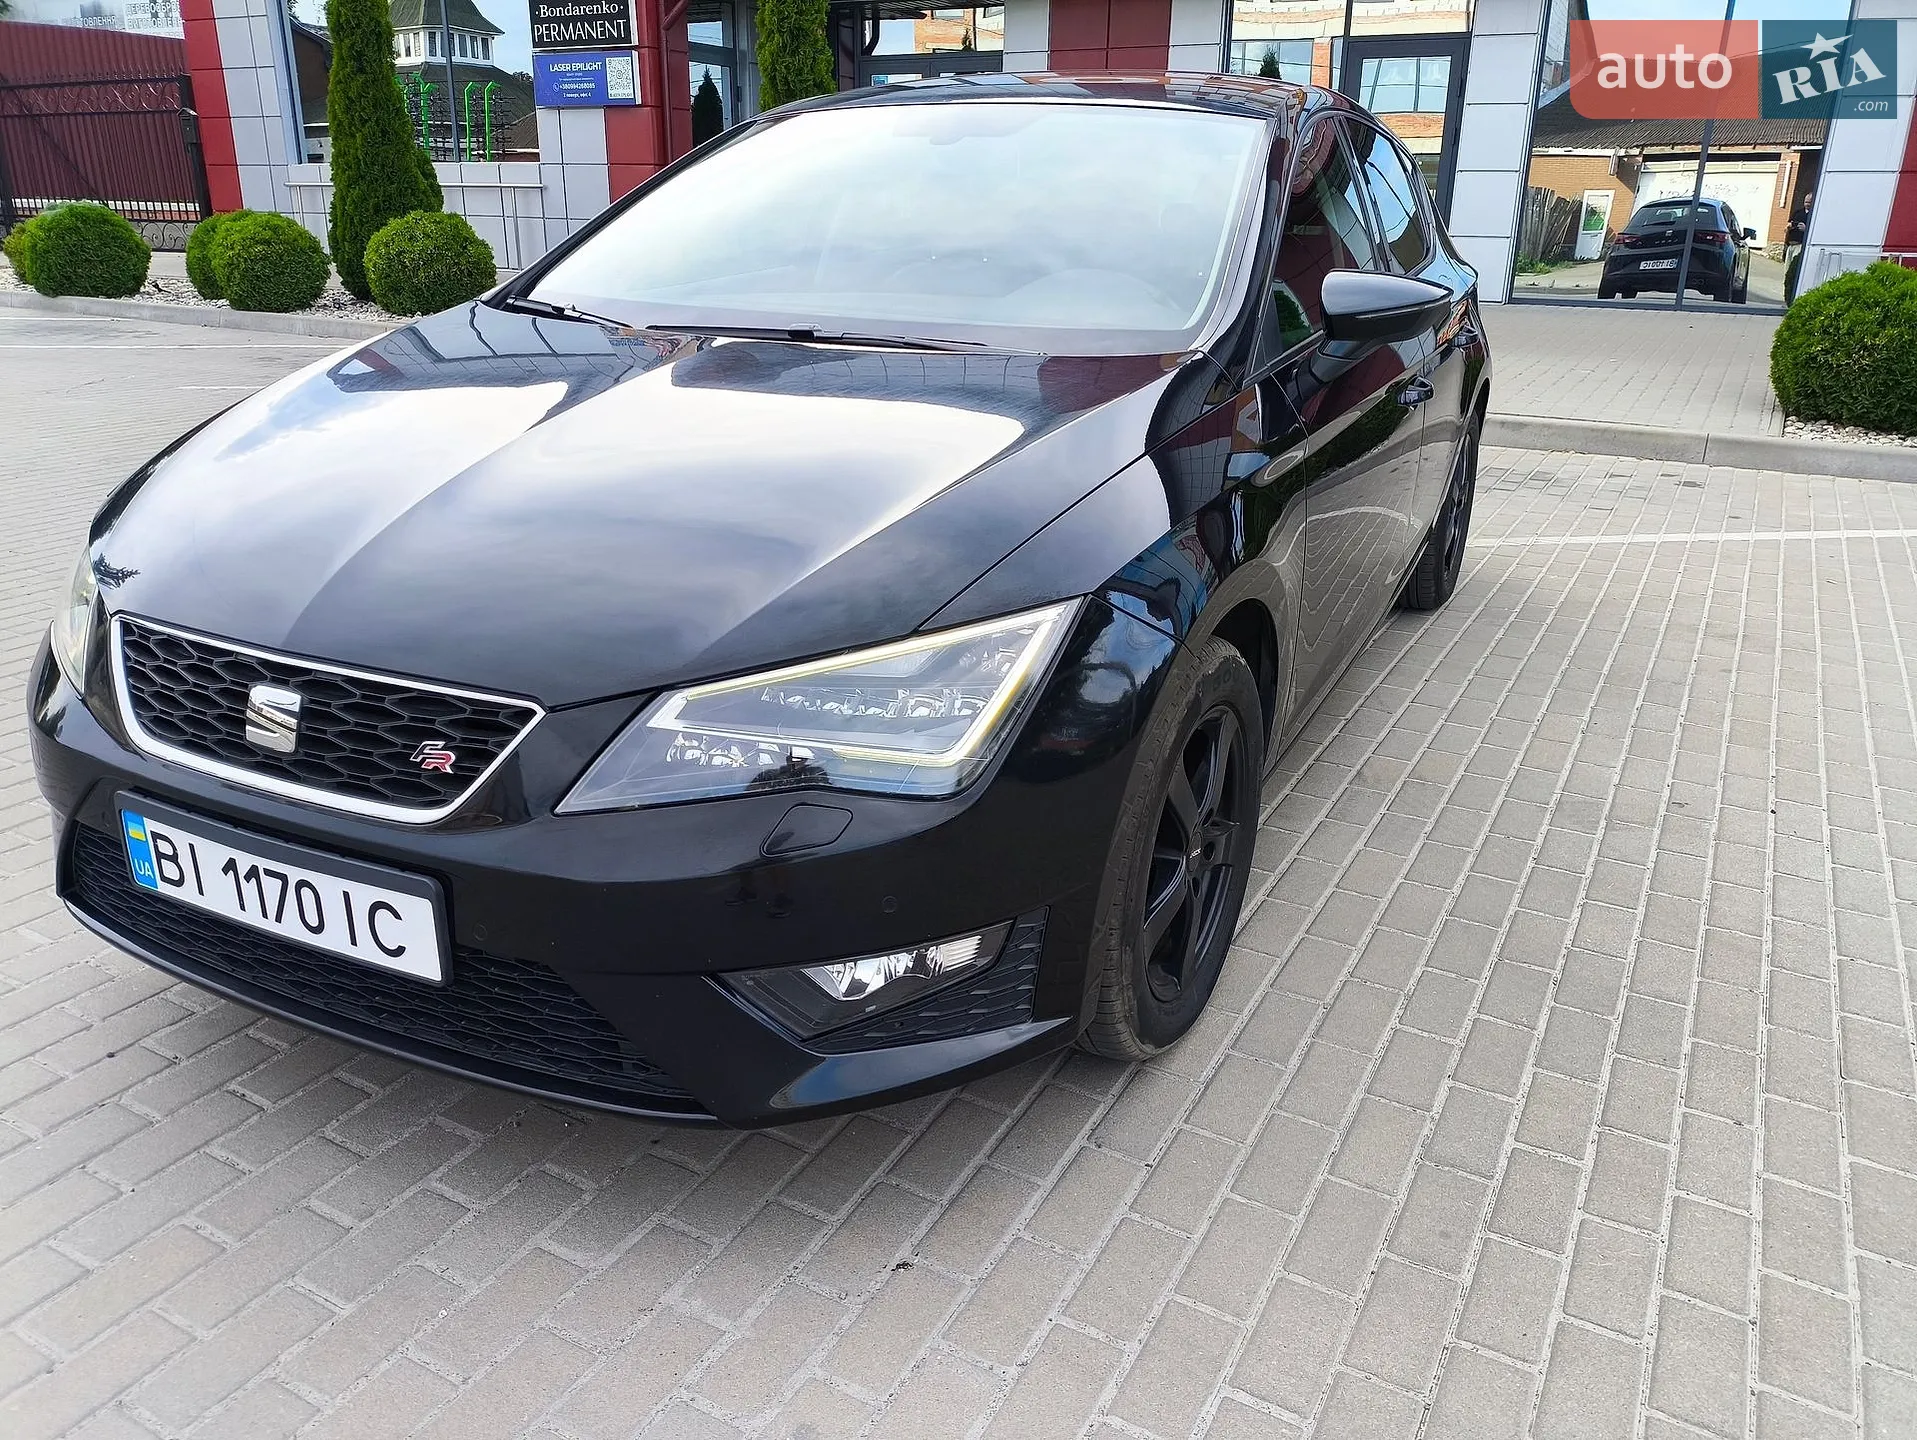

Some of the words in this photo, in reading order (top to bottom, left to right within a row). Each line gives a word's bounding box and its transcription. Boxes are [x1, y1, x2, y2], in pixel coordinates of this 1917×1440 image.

[539, 1, 618, 18] Bondarenko
[534, 19, 627, 42] PERMANENT
[549, 63, 571, 72] LASER
[572, 62, 602, 71] EPILIGHT
[409, 740, 454, 774] FR
[134, 858, 154, 880] UA
[149, 829, 205, 897] BI
[221, 857, 326, 936] 1170
[342, 890, 407, 959] IC
